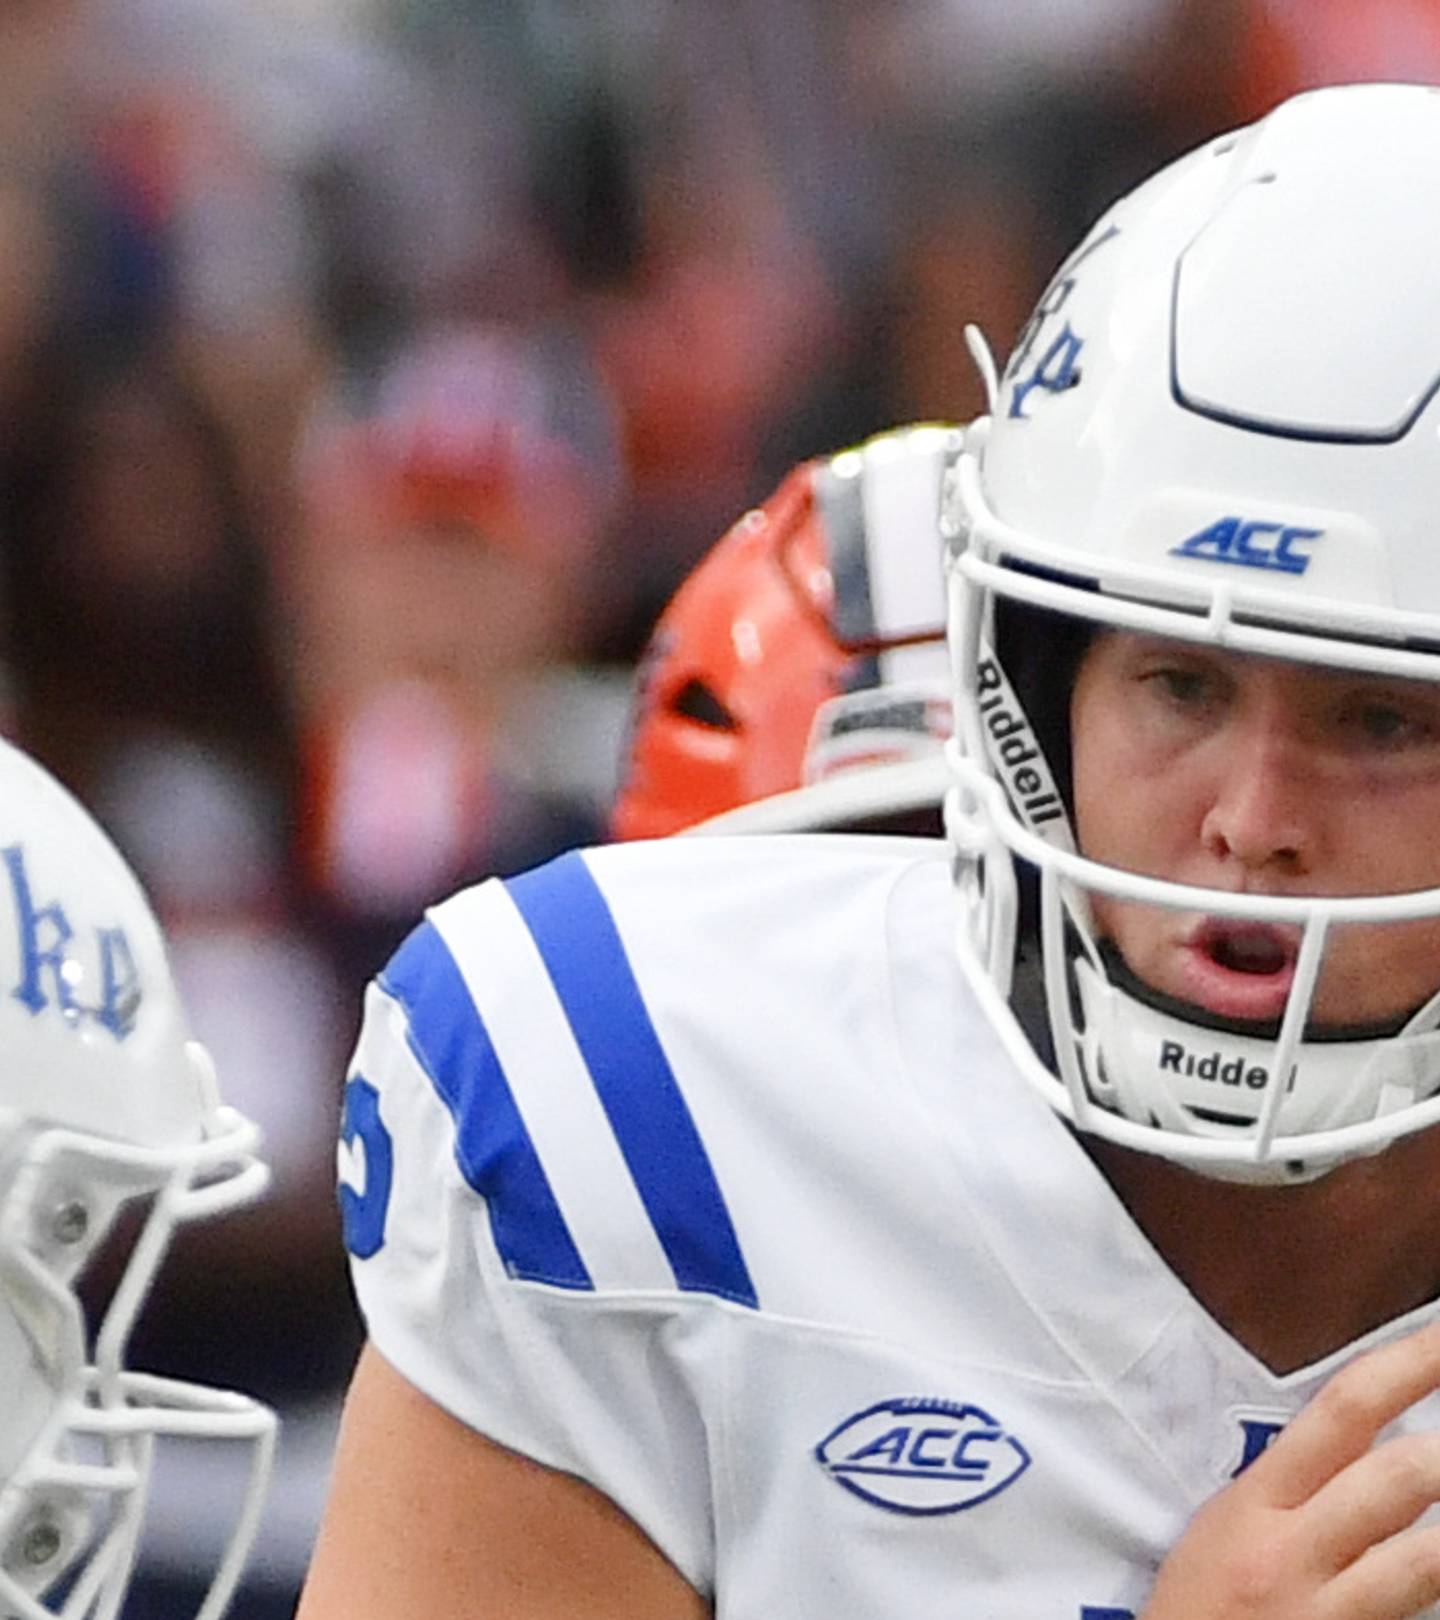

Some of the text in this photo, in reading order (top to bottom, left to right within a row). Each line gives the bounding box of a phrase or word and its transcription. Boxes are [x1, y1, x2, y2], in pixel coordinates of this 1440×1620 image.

[1168, 516, 1326, 576] ACC
[977, 658, 1063, 825] Riddell
[1159, 1039, 1298, 1093] Riddel
[847, 1426, 1003, 1470] ACC
